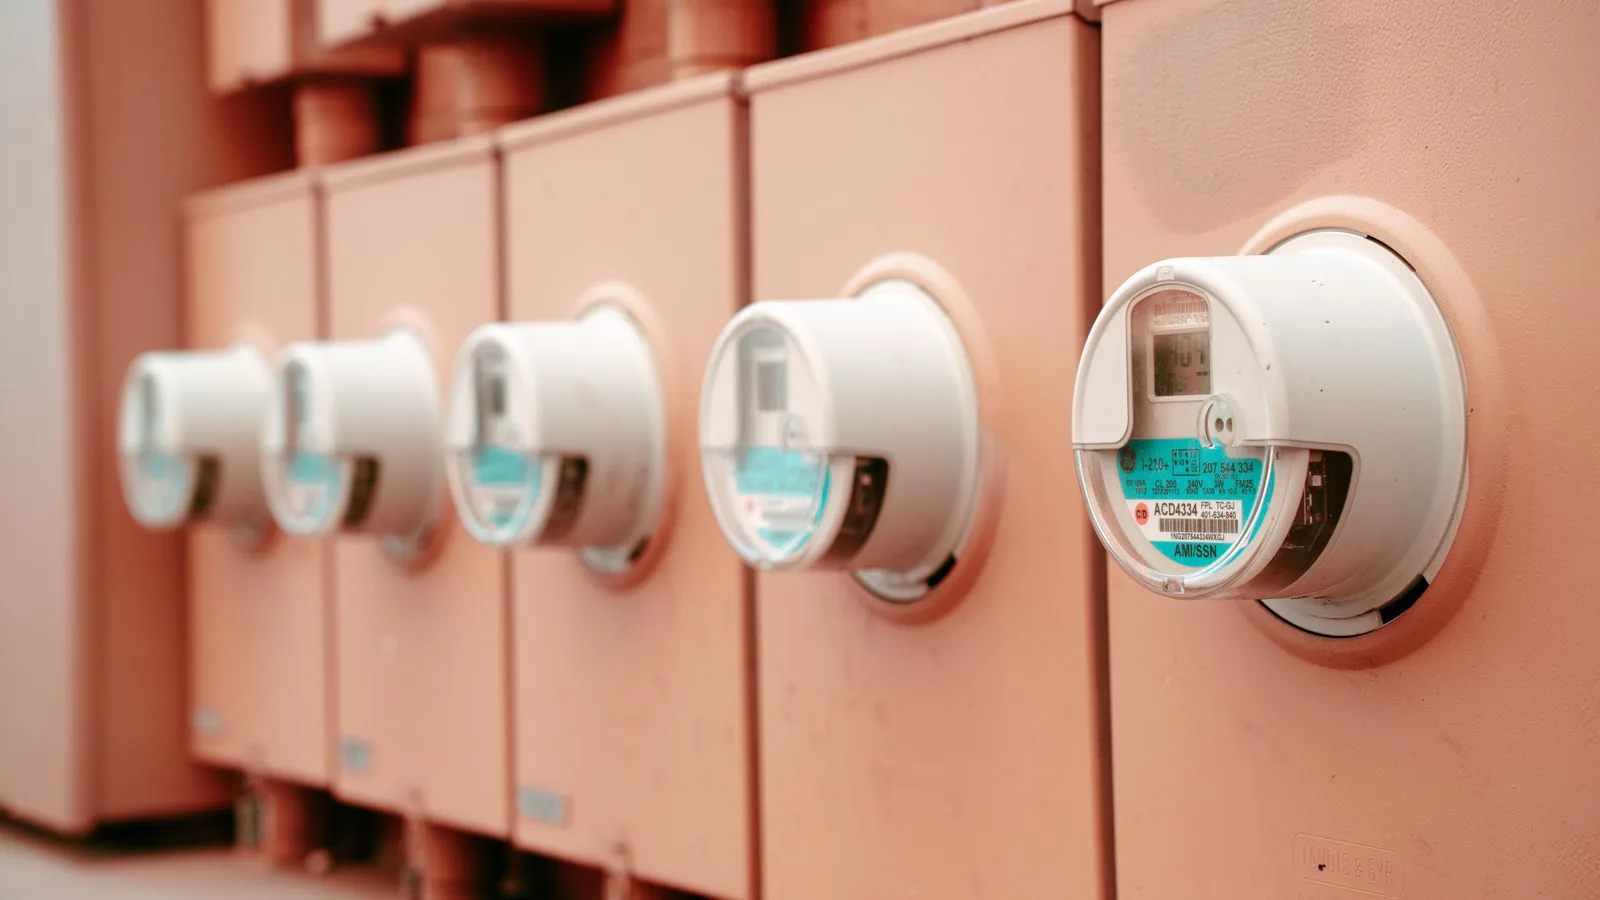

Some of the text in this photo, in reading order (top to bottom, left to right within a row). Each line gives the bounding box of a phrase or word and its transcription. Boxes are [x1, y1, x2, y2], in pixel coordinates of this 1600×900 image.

[1202, 462, 1254, 473] 207 544 334
[1155, 479, 1177, 489] CL 200
[1187, 479, 1204, 489] 240V
[1153, 502, 1198, 517] ACD4334
[1200, 501, 1235, 510] FPL TC-GJ
[1136, 509, 1148, 520] C/D
[1200, 510, 1237, 520] 401-634-840
[1174, 543, 1217, 558] AMI/SSN
